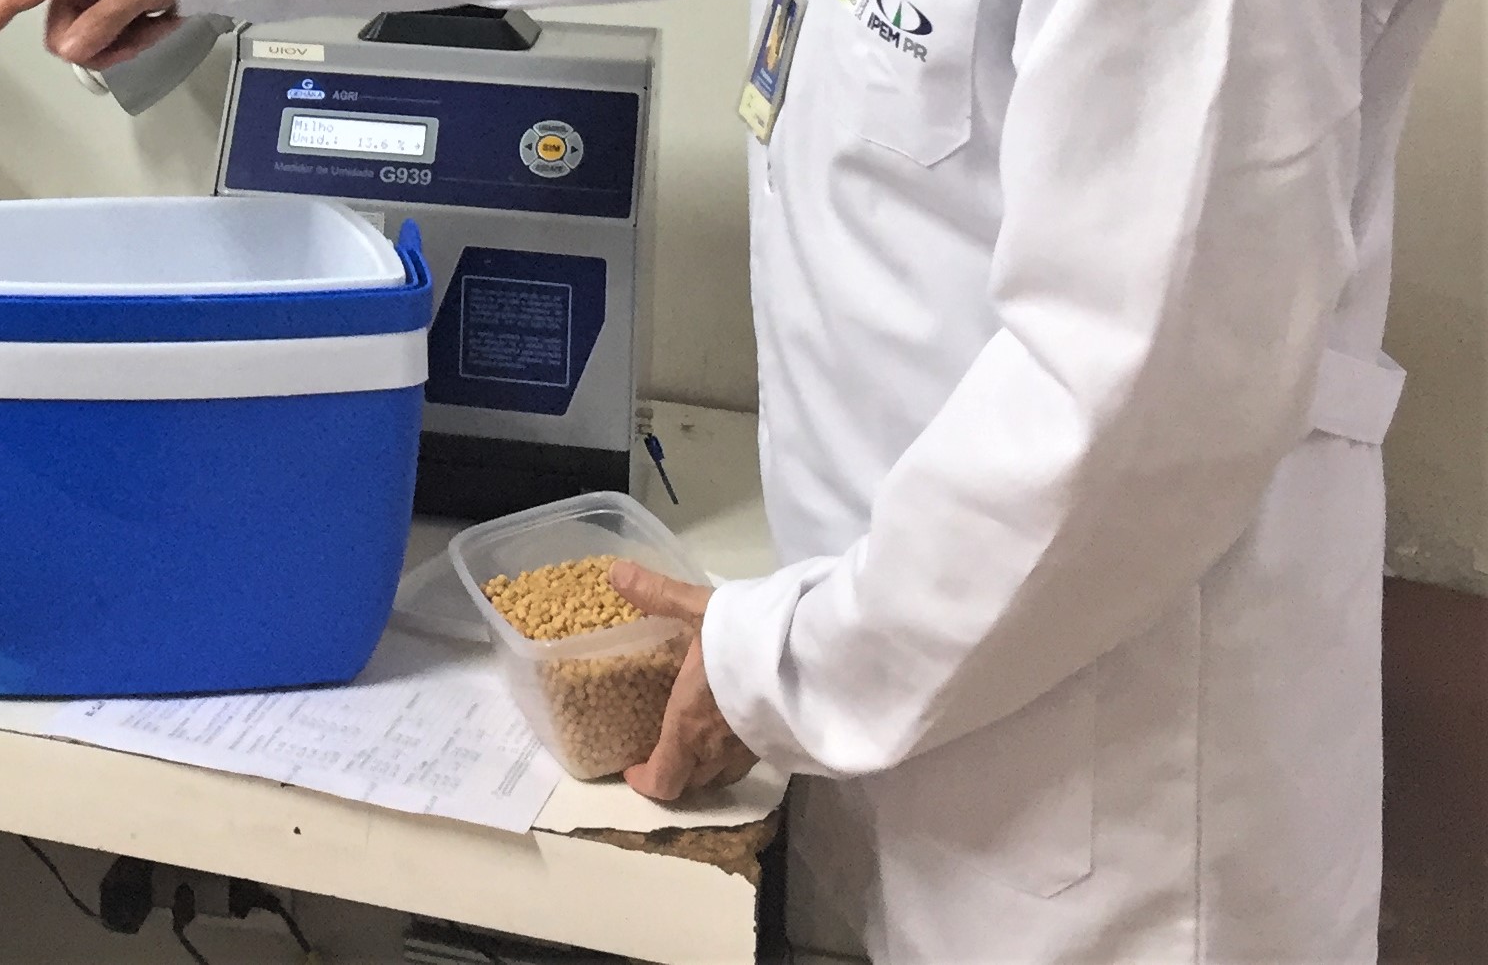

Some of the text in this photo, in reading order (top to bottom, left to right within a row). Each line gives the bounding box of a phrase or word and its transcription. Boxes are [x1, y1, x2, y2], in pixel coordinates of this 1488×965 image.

[867, 12, 928, 62] IPEM PR
[332, 90, 358, 101] AGRI
[294, 119, 334, 133] Milho
[379, 165, 432, 185] G939
